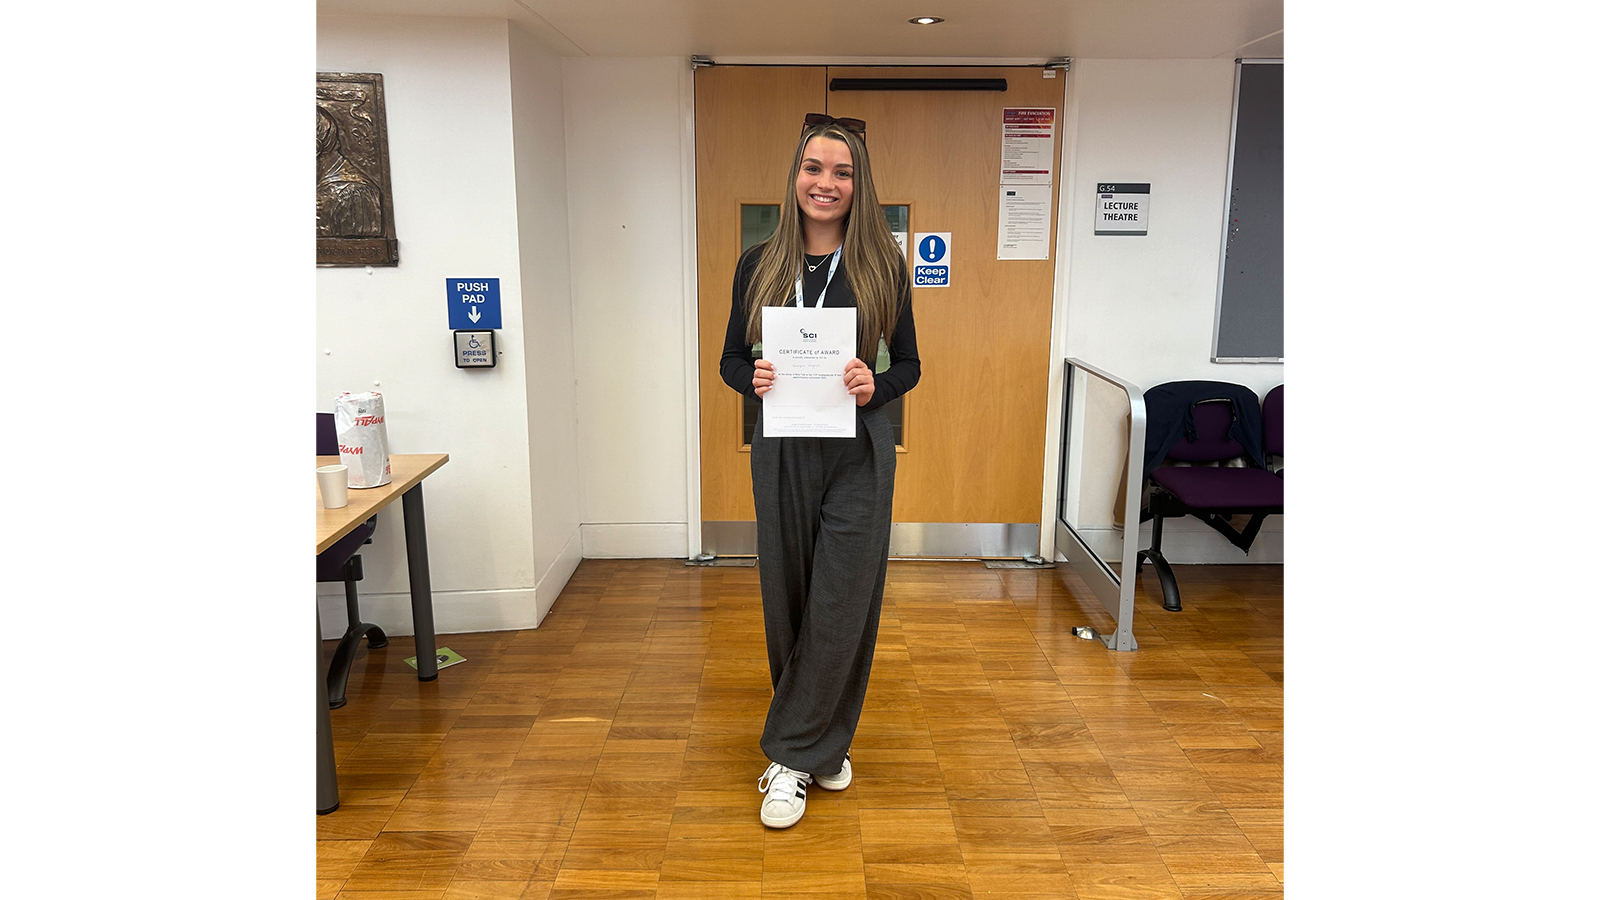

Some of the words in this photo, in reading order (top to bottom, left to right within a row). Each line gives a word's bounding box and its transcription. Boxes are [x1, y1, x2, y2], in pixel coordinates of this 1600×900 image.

[1103, 202, 1139, 211] LECTURE
[1103, 212, 1139, 221] THEATRE
[917, 267, 946, 277] Keep
[916, 276, 946, 284] Clear
[457, 282, 489, 292] PUSH
[462, 294, 486, 304] PAD
